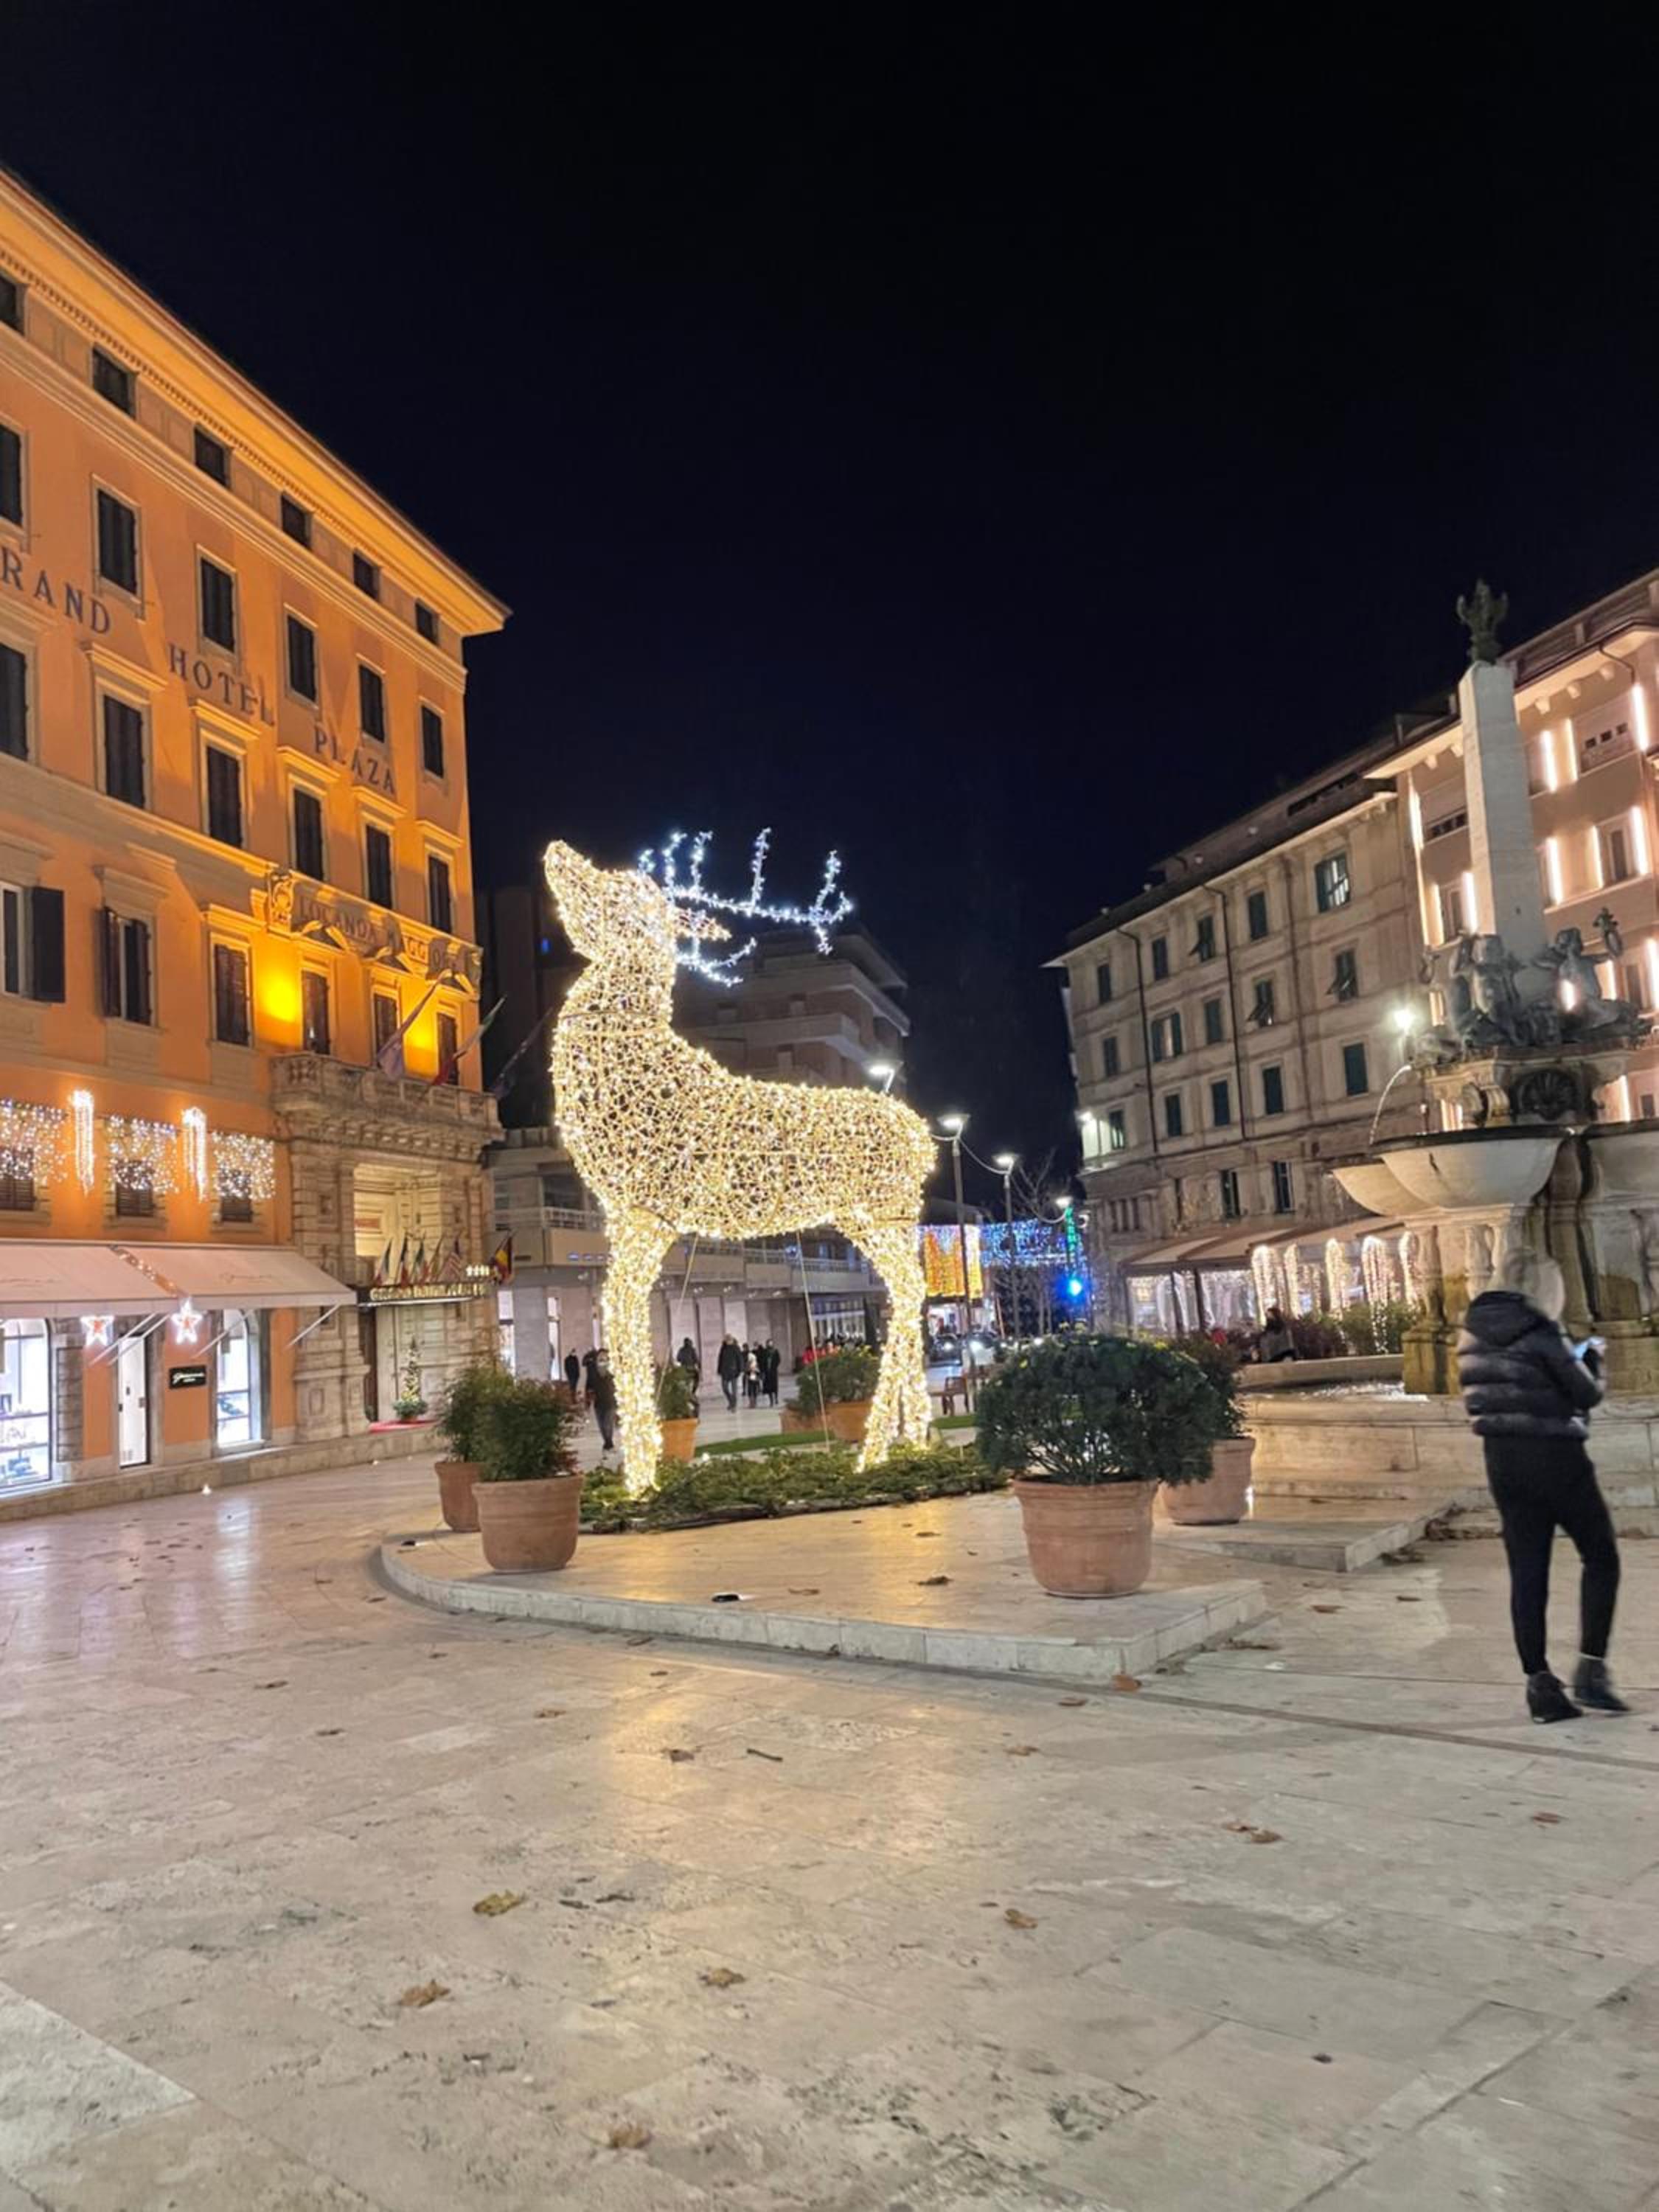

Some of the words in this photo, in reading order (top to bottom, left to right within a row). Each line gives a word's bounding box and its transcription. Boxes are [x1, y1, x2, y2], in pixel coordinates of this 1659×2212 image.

[1, 544, 110, 635] RAND
[169, 643, 275, 726] HOTEL
[314, 724, 395, 795] PLAZA
